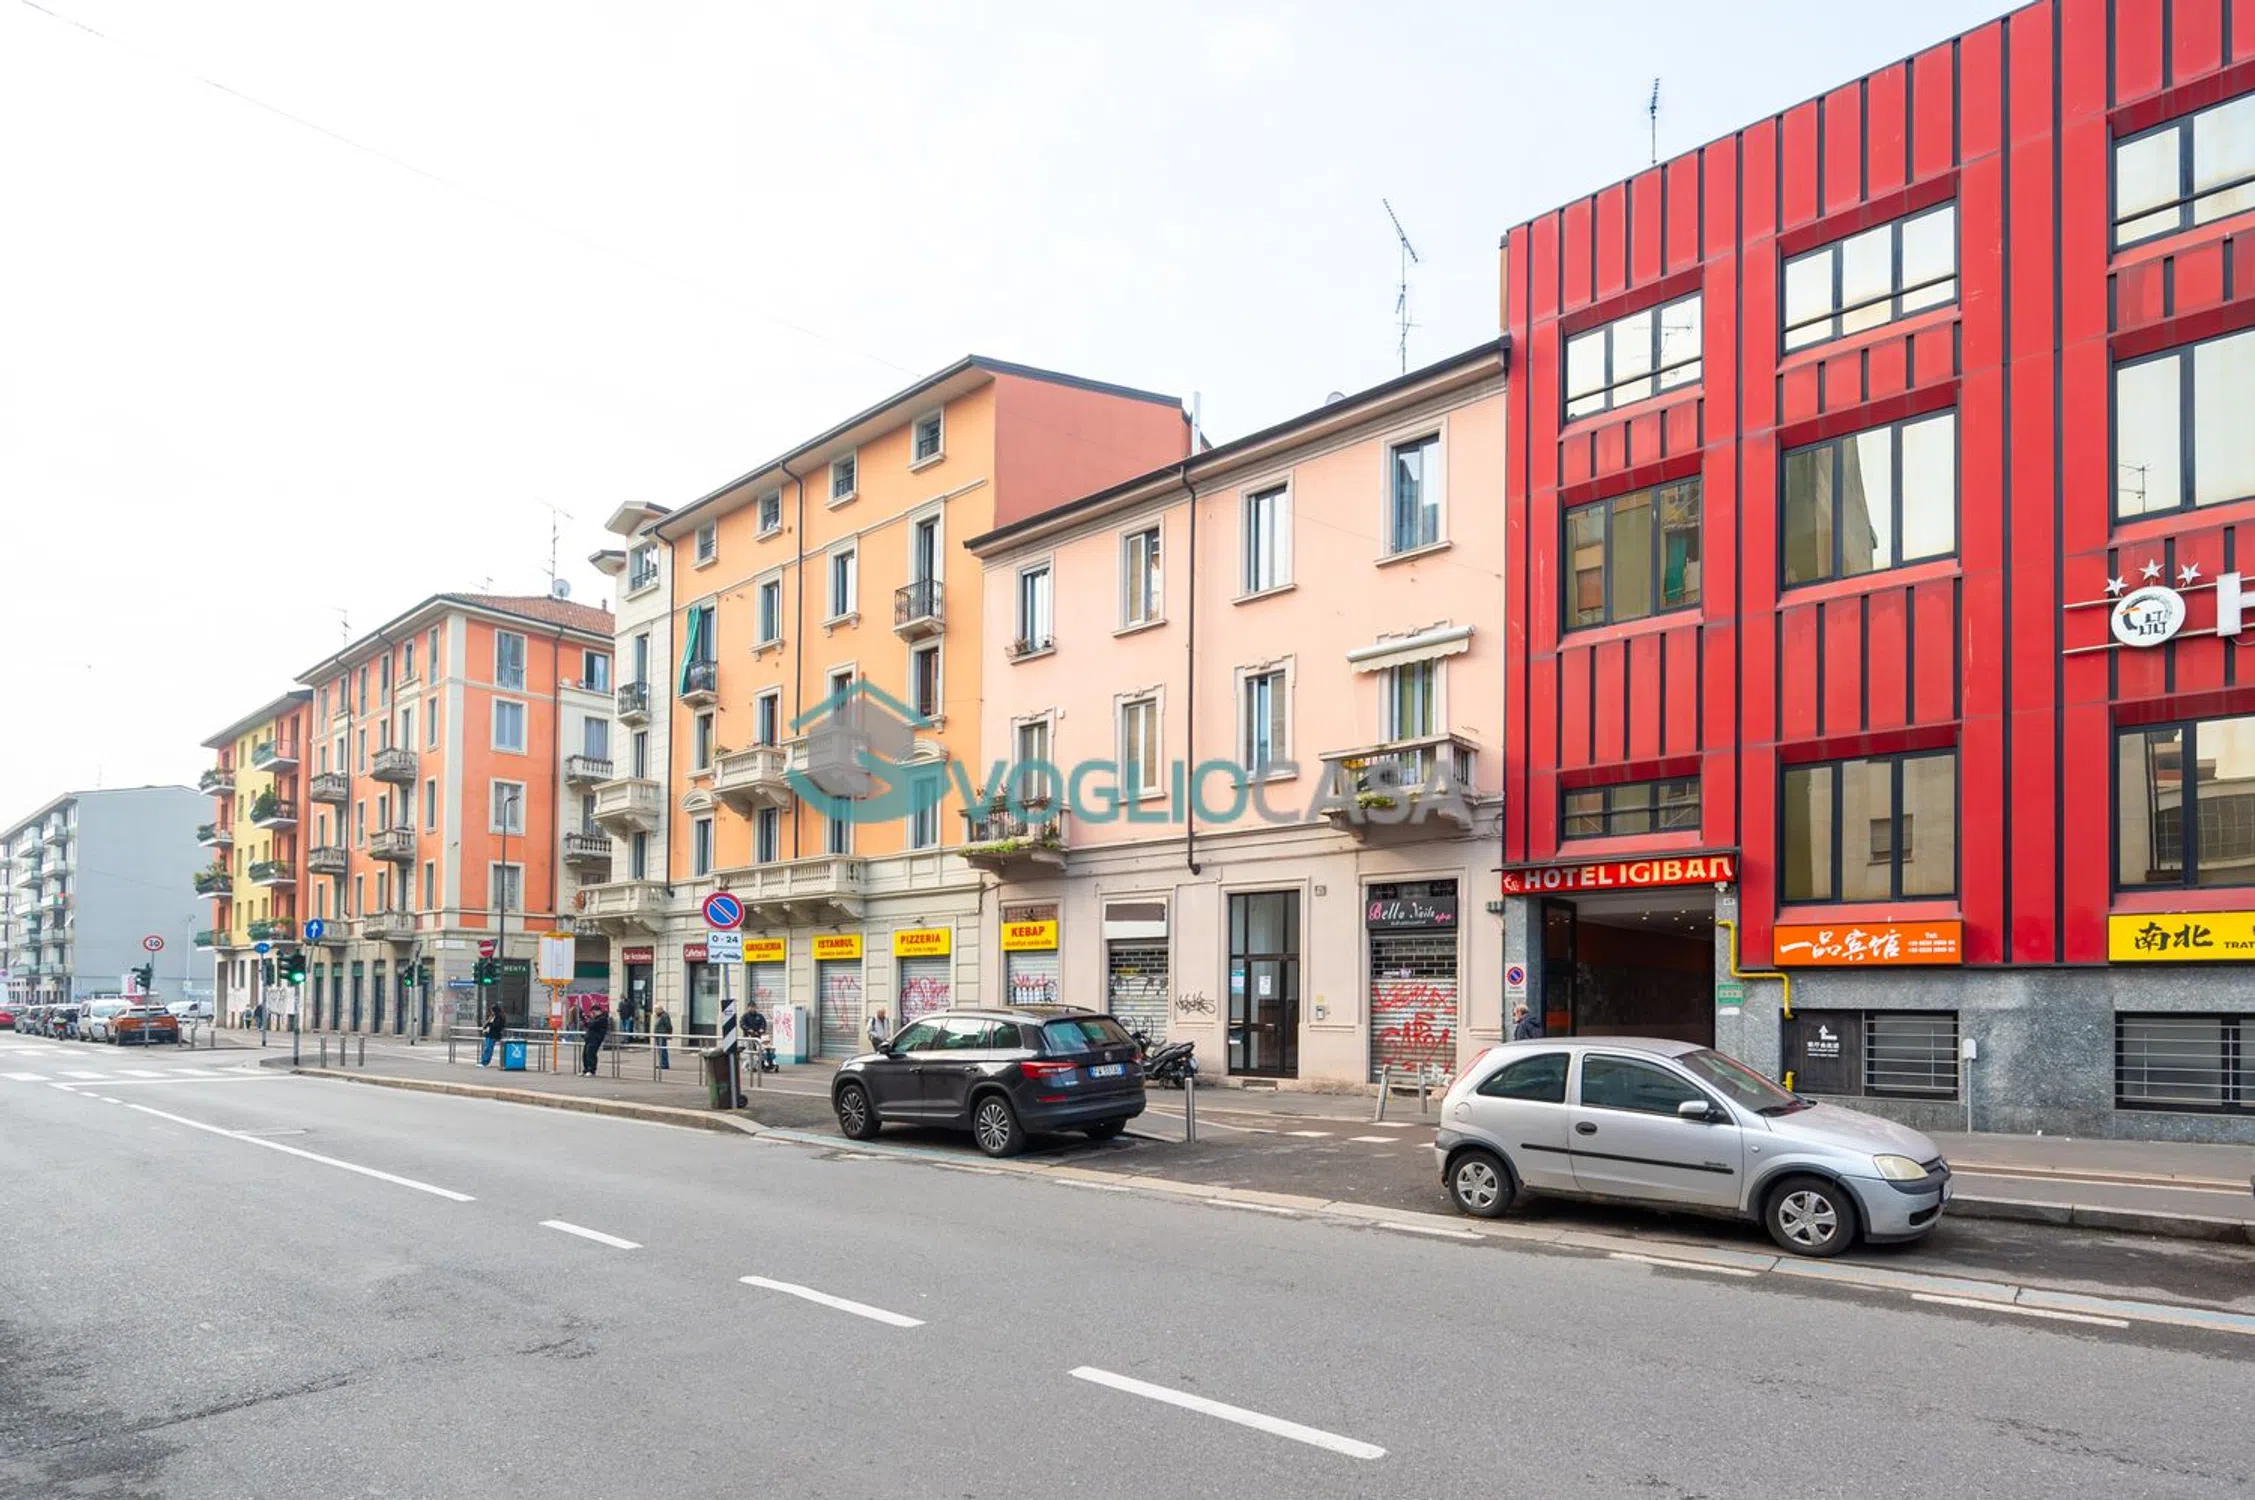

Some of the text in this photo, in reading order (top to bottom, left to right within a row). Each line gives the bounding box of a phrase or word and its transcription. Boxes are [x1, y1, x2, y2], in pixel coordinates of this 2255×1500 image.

[1524, 857, 1733, 890] HOTEL IGIBAN
[900, 933, 941, 945] PIZZERIA
[1011, 926, 1046, 938] KEBAP
[2134, 921, 2214, 953] 南北
[818, 938, 854, 949] ISTANBUL
[1779, 928, 1902, 961] 一品宾馆
